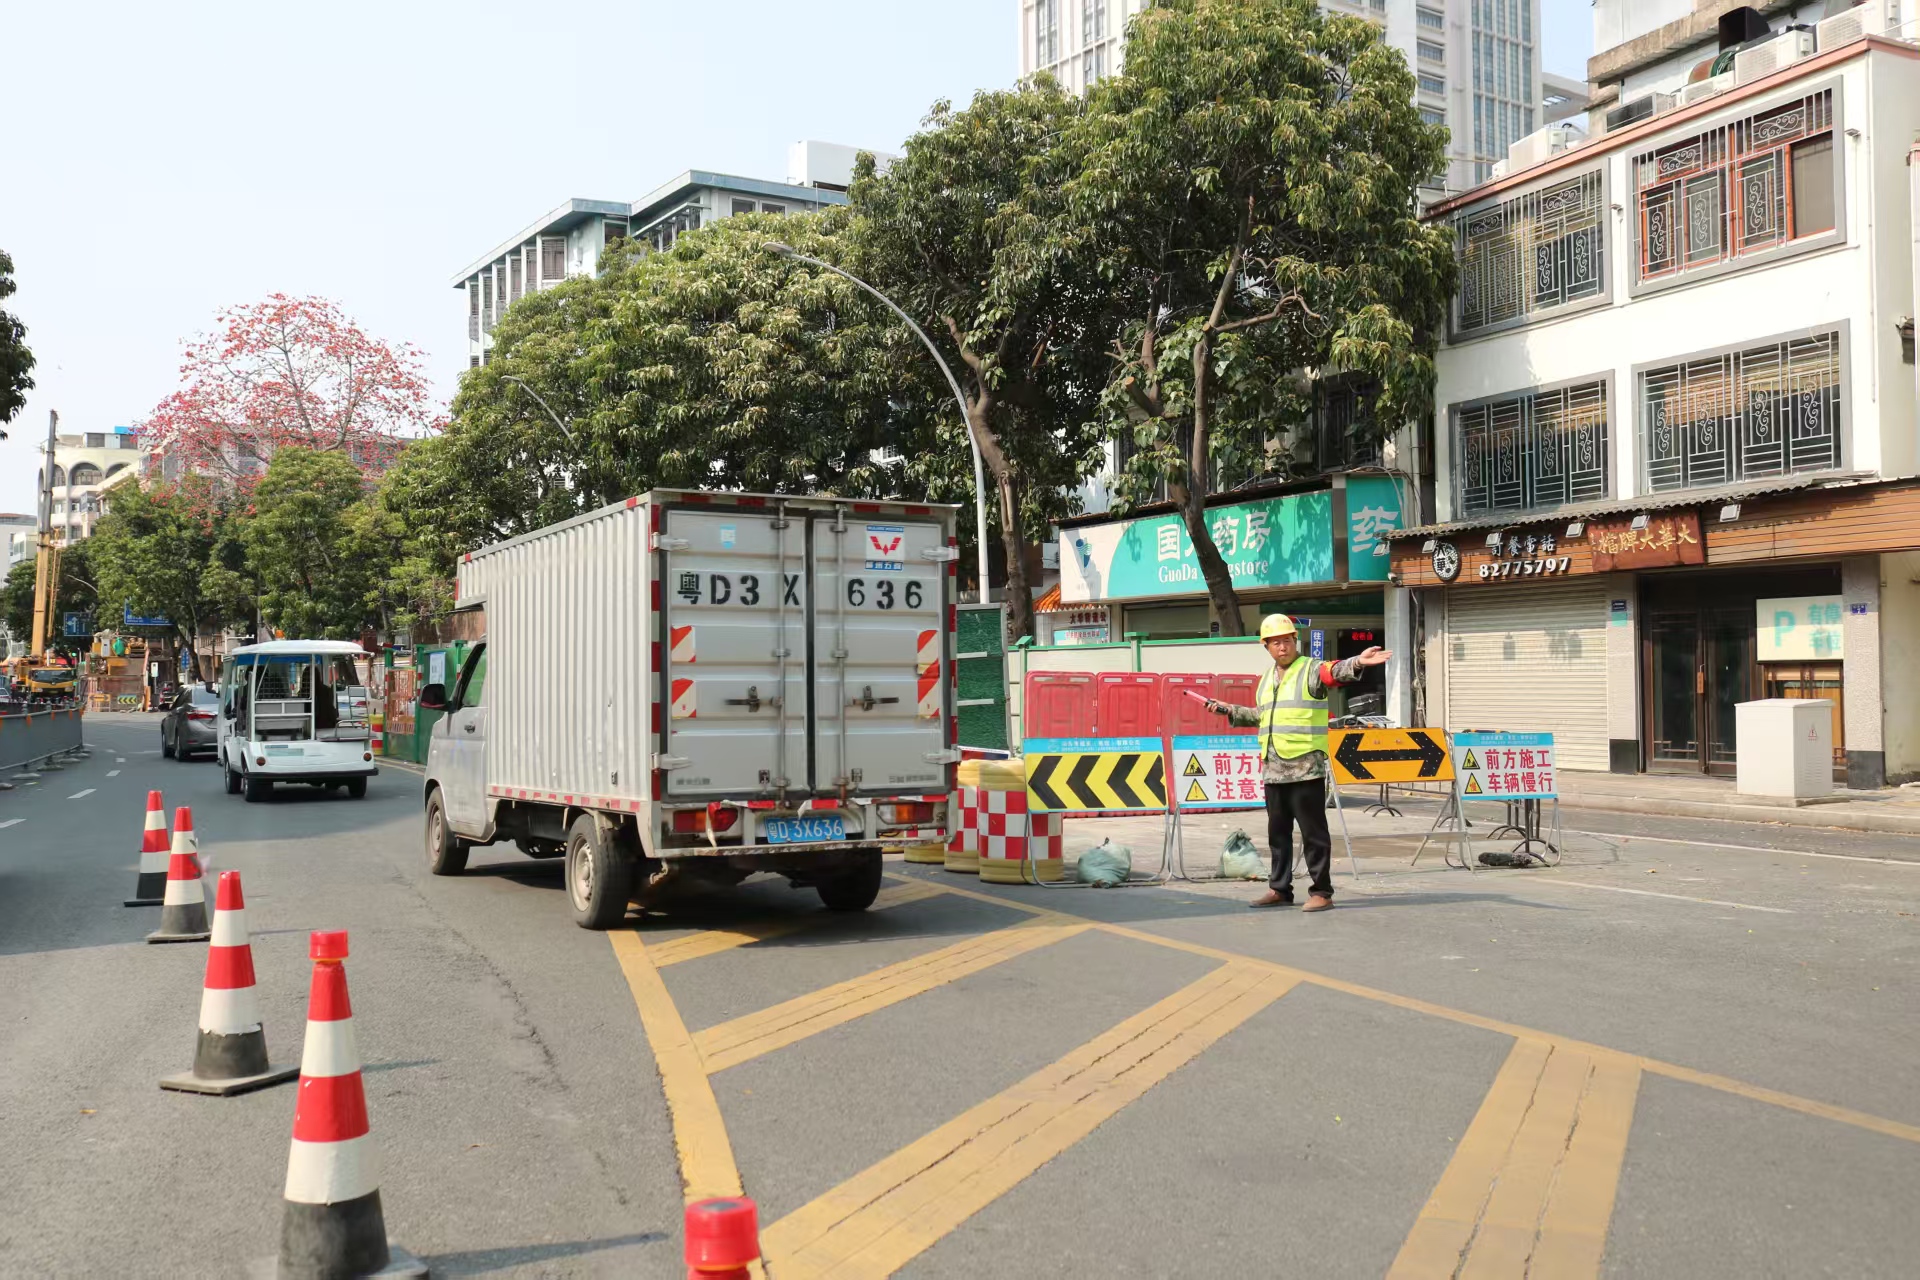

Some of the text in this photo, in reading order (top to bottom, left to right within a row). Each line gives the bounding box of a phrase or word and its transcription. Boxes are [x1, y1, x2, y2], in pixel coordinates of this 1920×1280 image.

[1158, 563, 1198, 583] GuoDa
[1479, 557, 1569, 578] 82775797
[1774, 611, 1796, 647] P
[1313, 631, 1322, 660] 往中心
[1485, 749, 1551, 770] 前方施工
[1216, 779, 1266, 800] 注意
[1488, 772, 1553, 793] 车辆慢行
